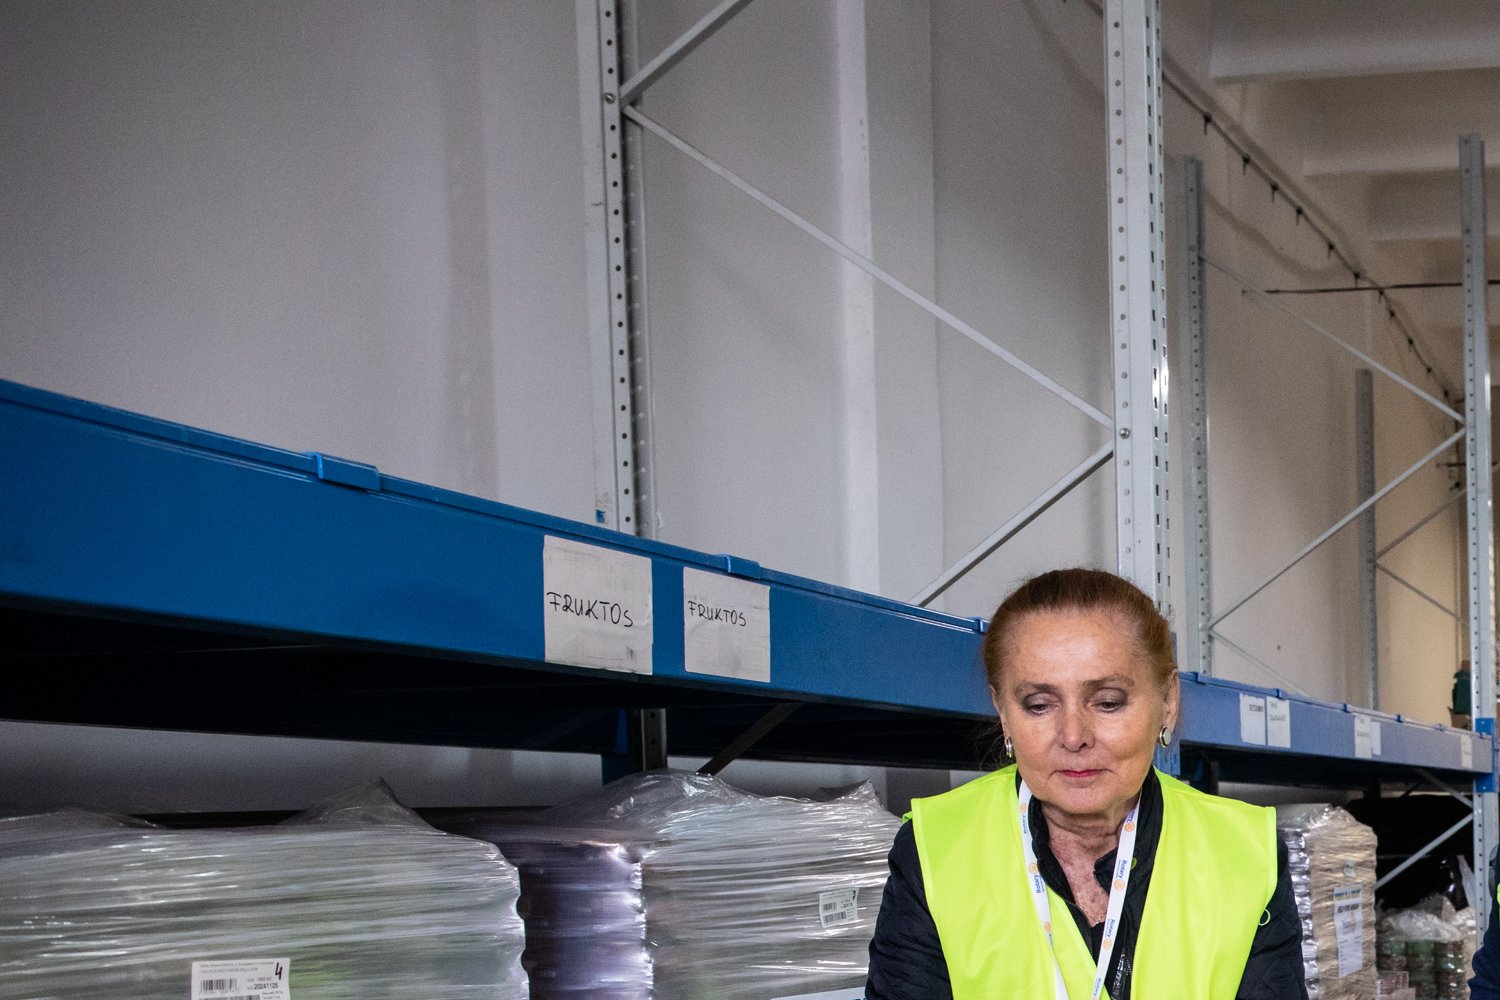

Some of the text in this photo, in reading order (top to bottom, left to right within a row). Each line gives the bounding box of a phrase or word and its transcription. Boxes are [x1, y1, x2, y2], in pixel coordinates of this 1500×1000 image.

[546, 592, 633, 628] FRUKTOS
[688, 600, 747, 627] FRUKTOS
[275, 962, 283, 980] 4
